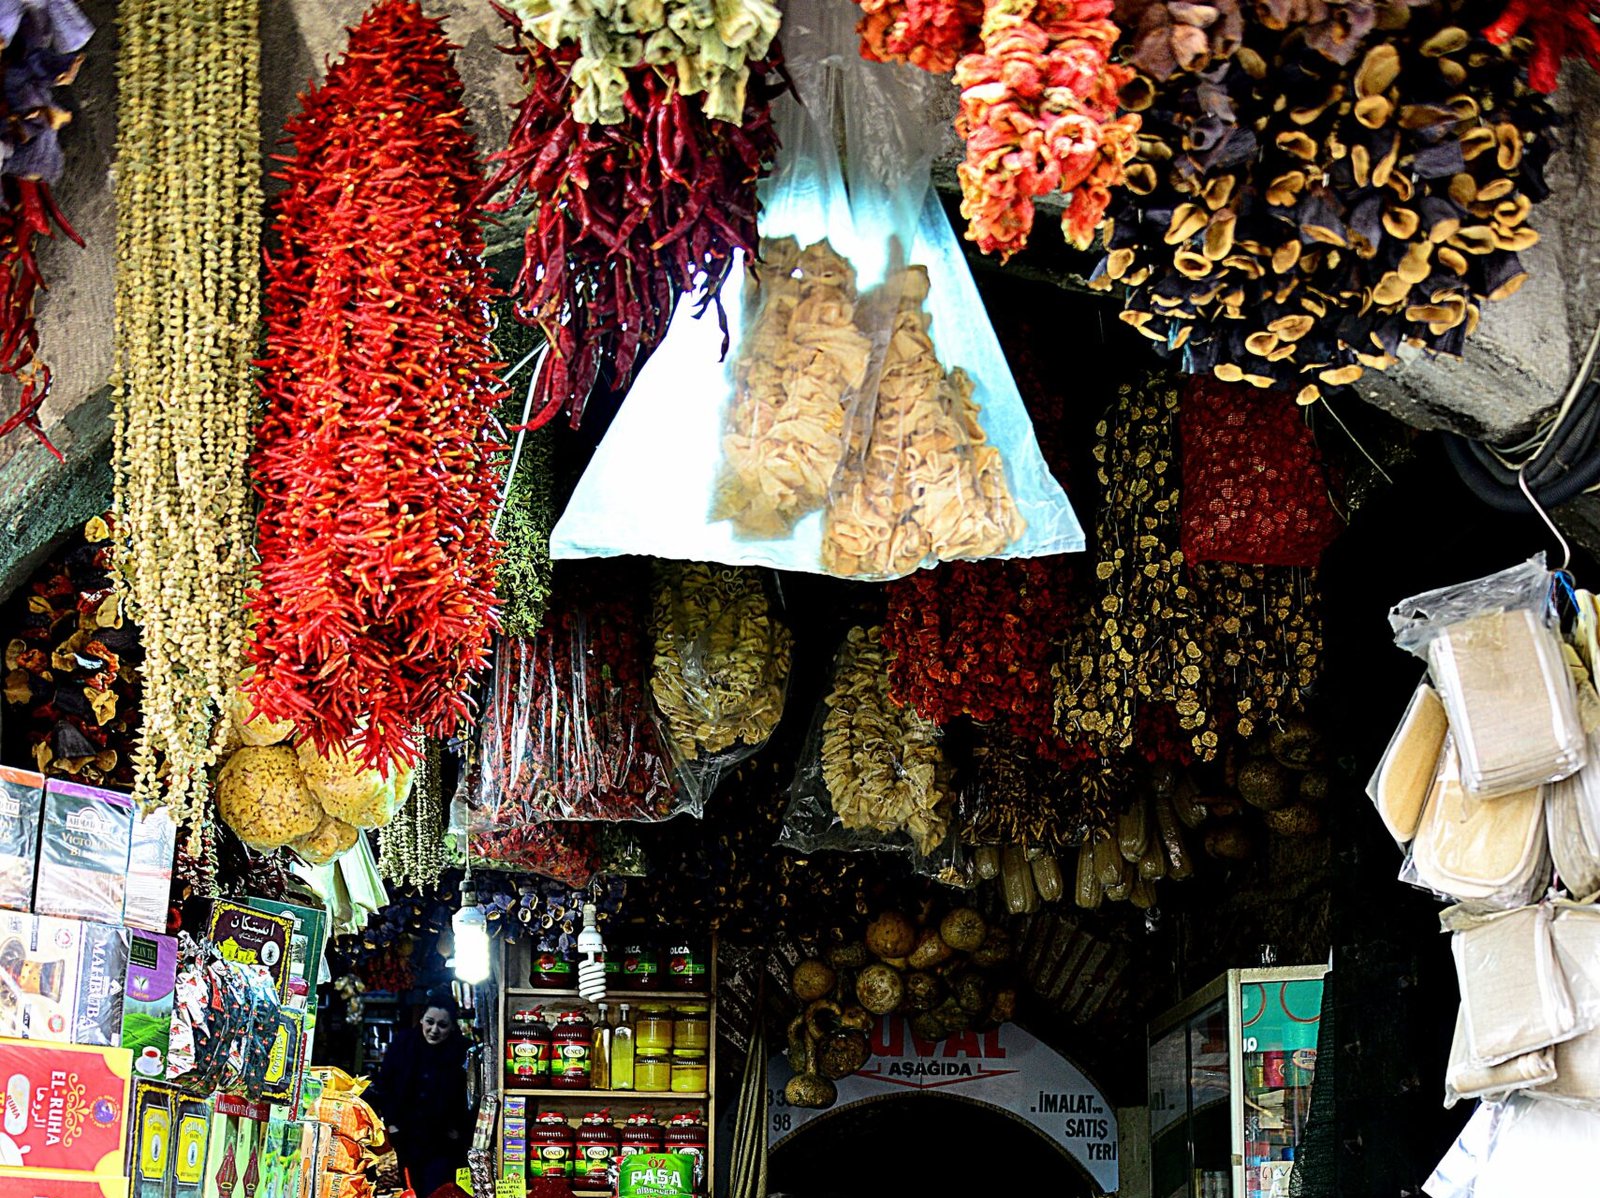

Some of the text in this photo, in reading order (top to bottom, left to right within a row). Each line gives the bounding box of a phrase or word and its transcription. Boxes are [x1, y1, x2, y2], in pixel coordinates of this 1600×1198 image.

[888, 1059, 973, 1078] AŞAĞIDA
[45, 1070, 67, 1146] EL-RUHA
[1039, 1090, 1094, 1114] İMALAT
[1065, 1118, 1109, 1140] SATIŞ
[1086, 1140, 1117, 1161] YERİ
[647, 1156, 667, 1169] ÖZ
[630, 1168, 682, 1189] PAŞA
